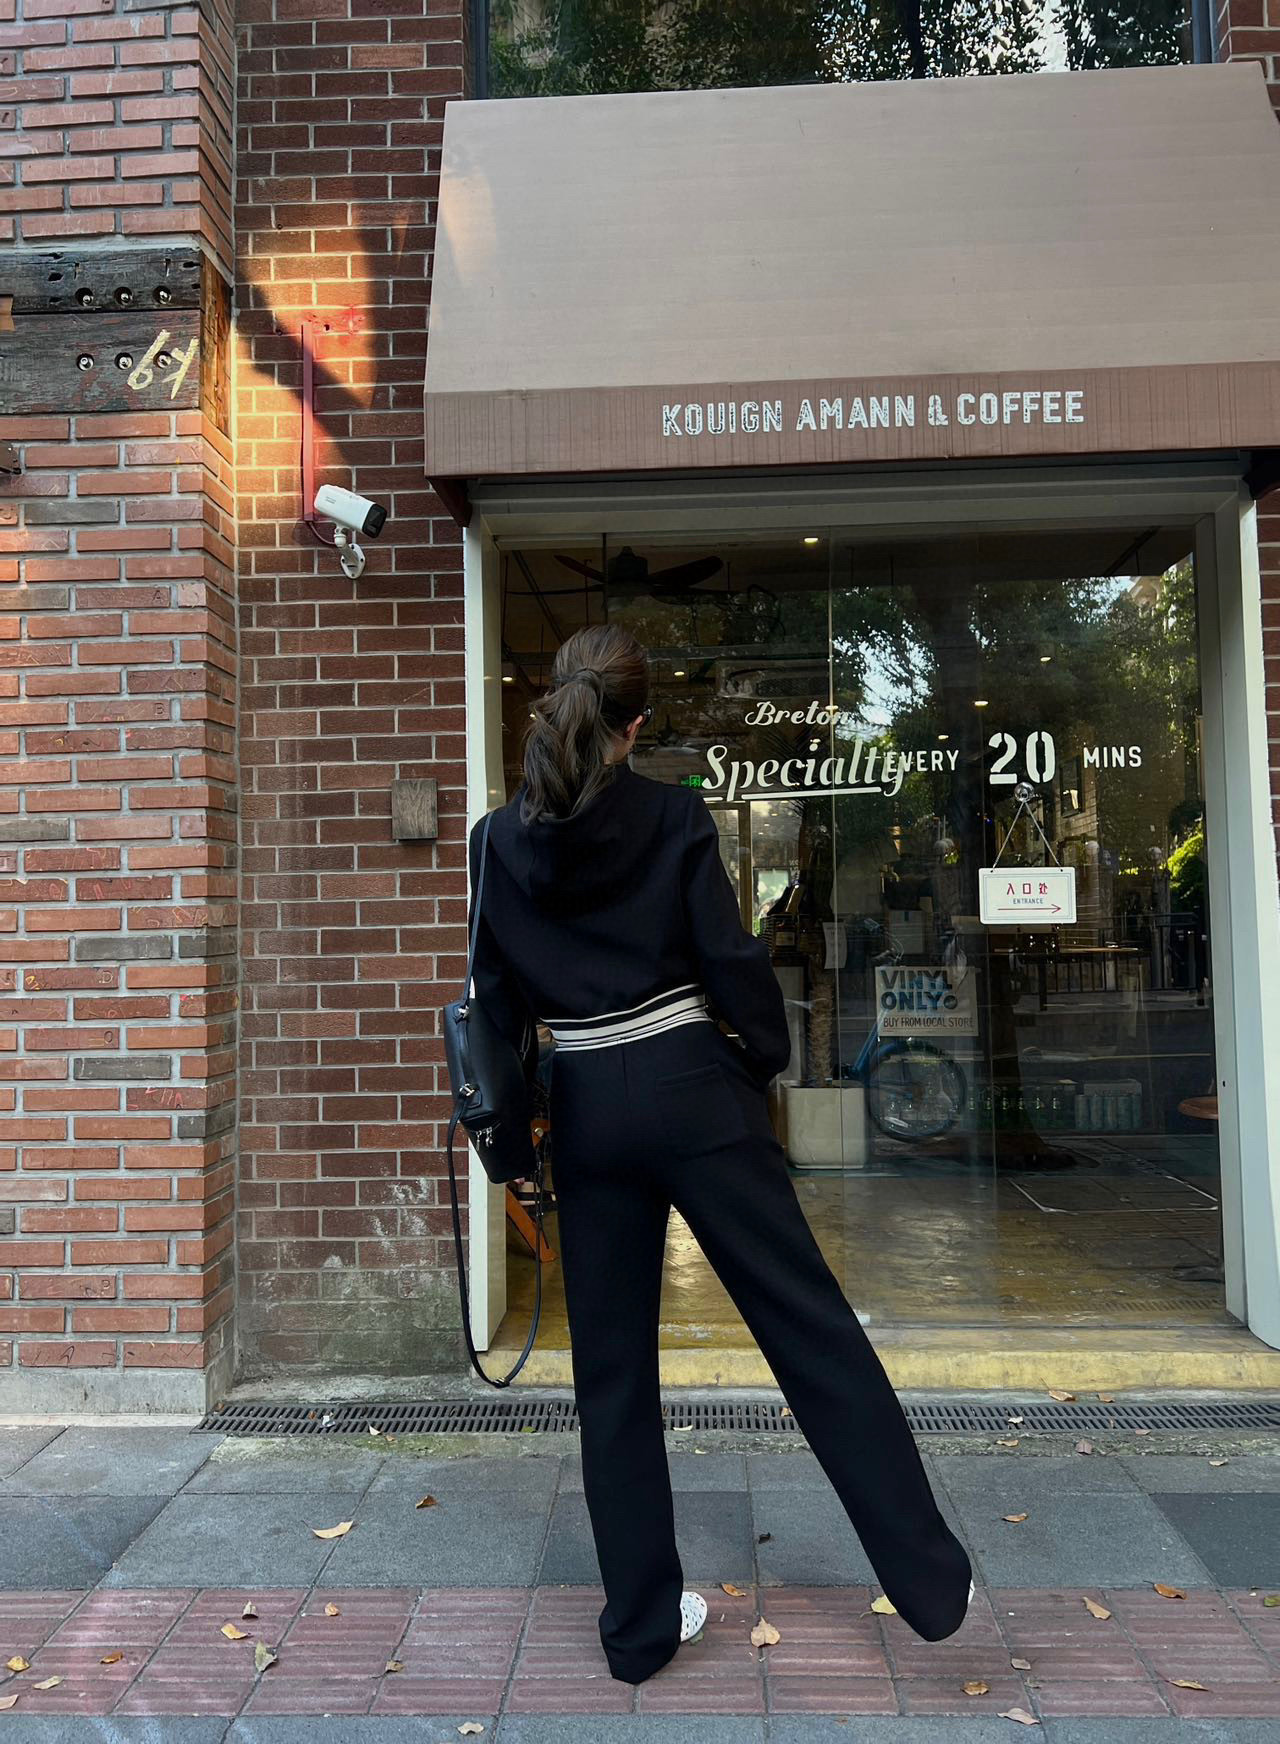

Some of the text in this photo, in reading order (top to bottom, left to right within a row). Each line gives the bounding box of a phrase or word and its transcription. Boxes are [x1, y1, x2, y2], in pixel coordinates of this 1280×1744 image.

[662, 390, 1084, 437] KOUIGN AMANN & COFFEE
[744, 700, 848, 726] Breton
[886, 730, 1142, 785] EVERY 20 MINS
[701, 738, 906, 802] Specialty
[1006, 882, 1048, 895] 入口处
[880, 970, 952, 990] VINYL
[881, 991, 943, 1011] ONLY
[884, 1017, 974, 1028] BUY FROM LOCAL STORE
